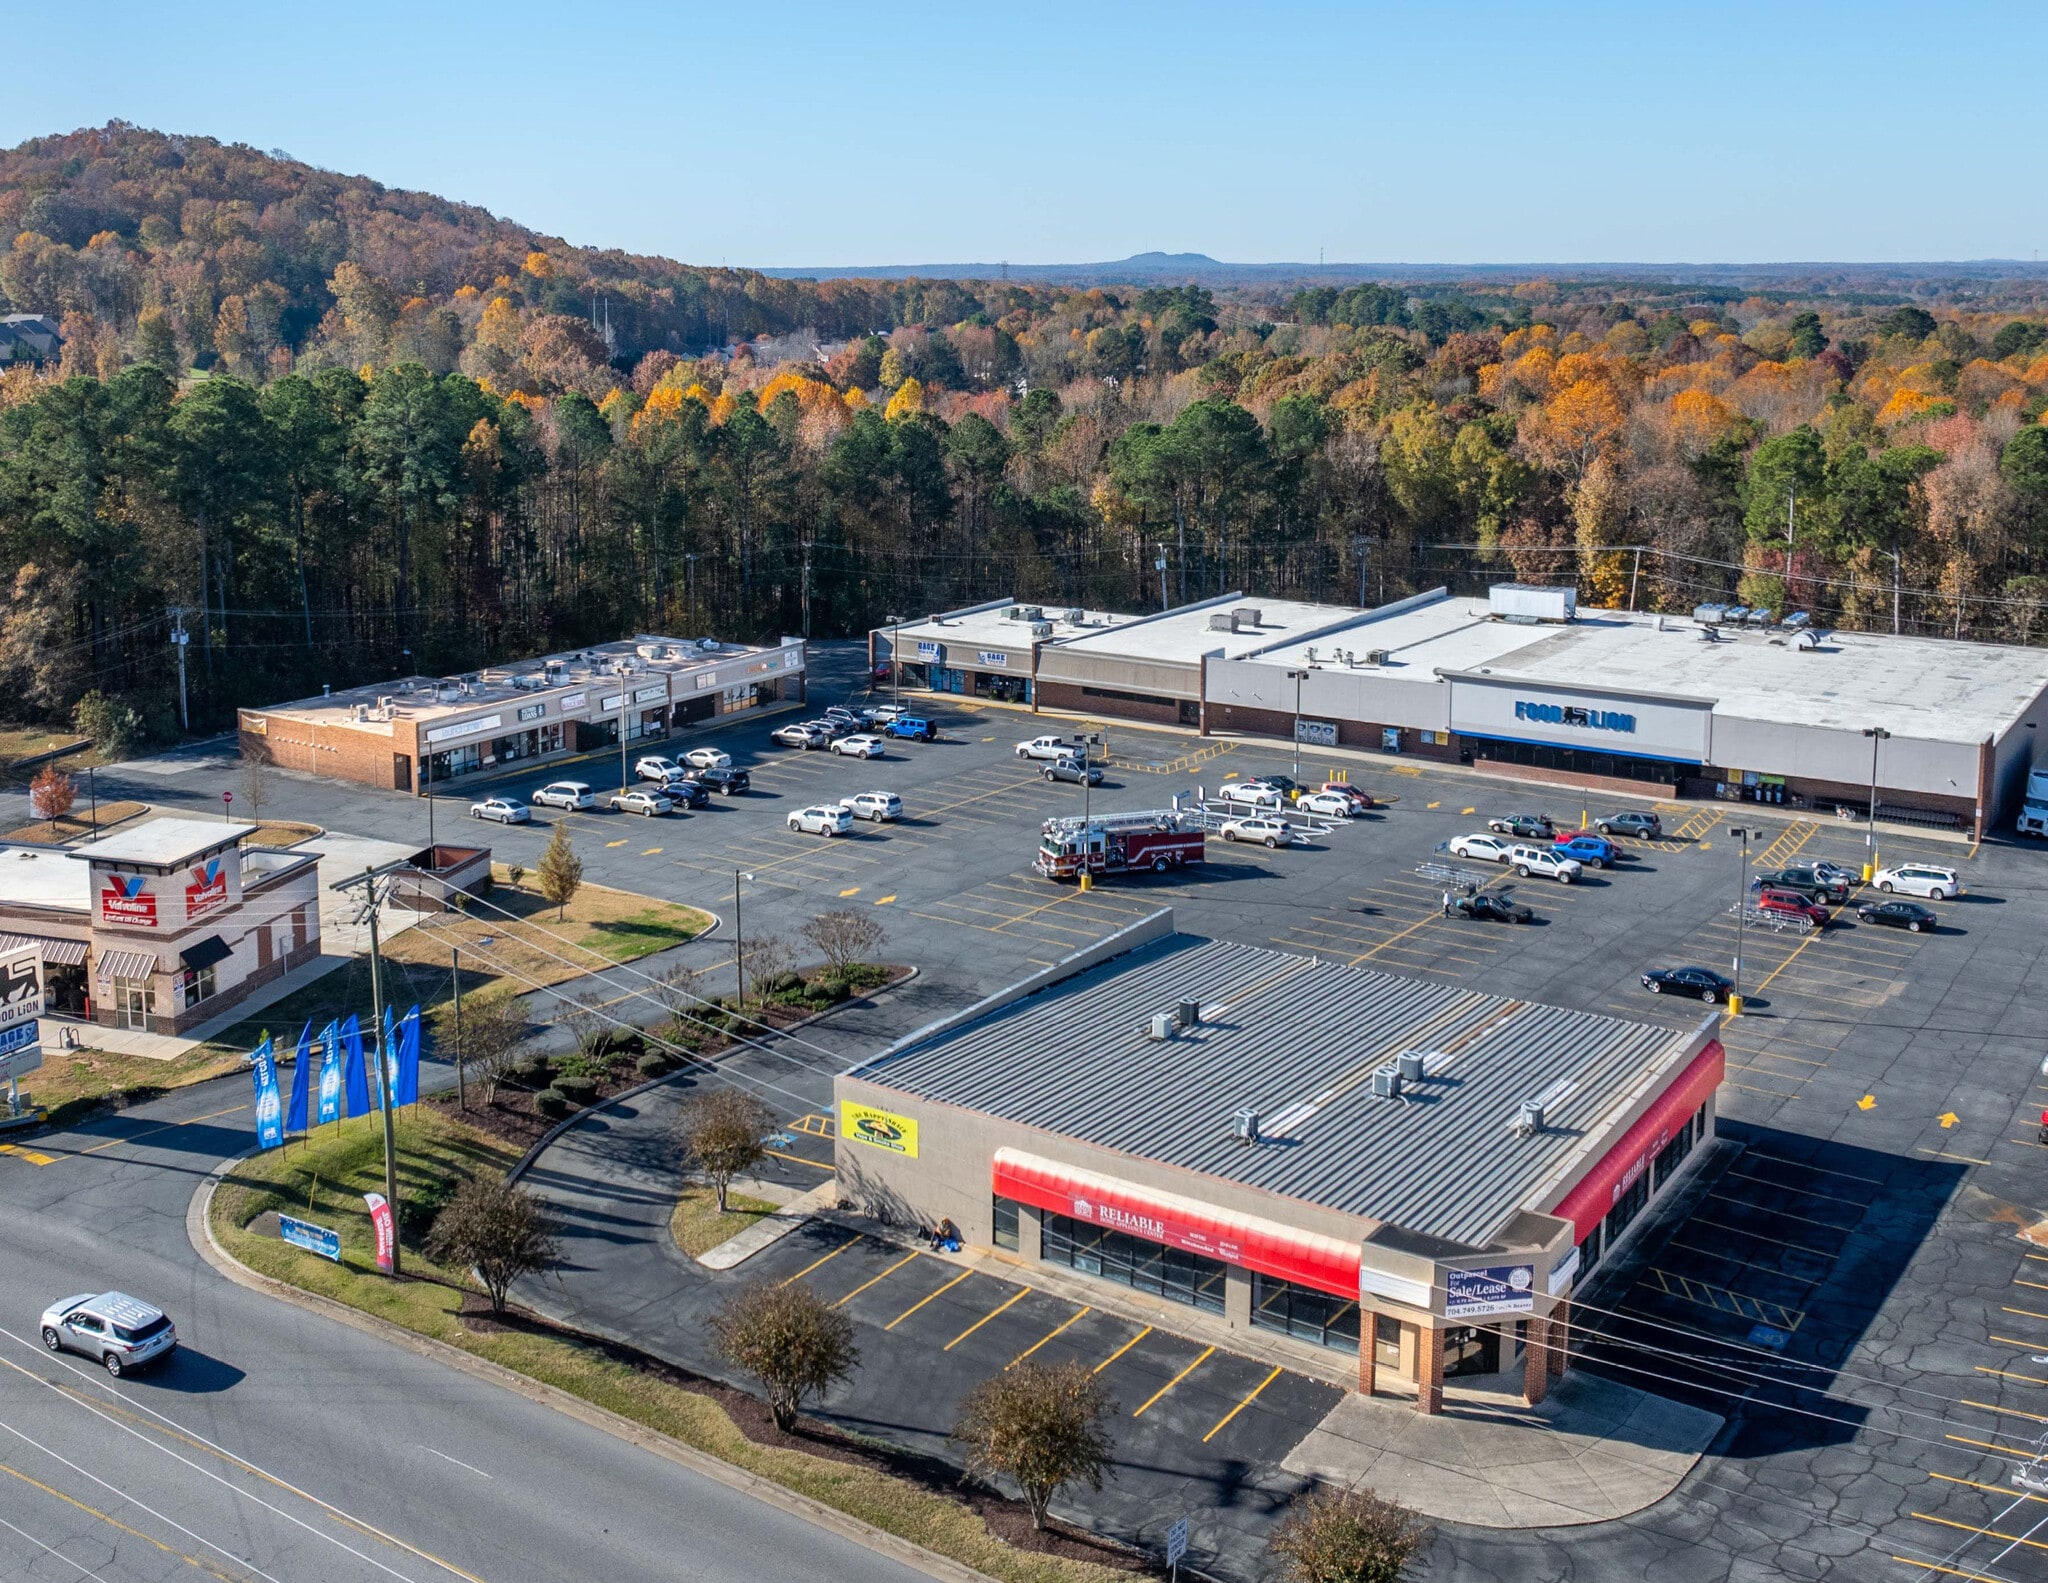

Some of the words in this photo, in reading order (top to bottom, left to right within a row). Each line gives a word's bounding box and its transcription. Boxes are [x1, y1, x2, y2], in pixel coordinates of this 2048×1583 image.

[1515, 701, 1562, 723] FOOD
[1590, 710, 1636, 733] LION
[194, 885, 223, 903] Valvoline
[108, 900, 148, 913] Valvoline
[1099, 1205, 1164, 1233] RELIABLE
[1449, 1269, 1488, 1280] Outparcel
[1449, 1284, 1507, 1298] Sale/Lease
